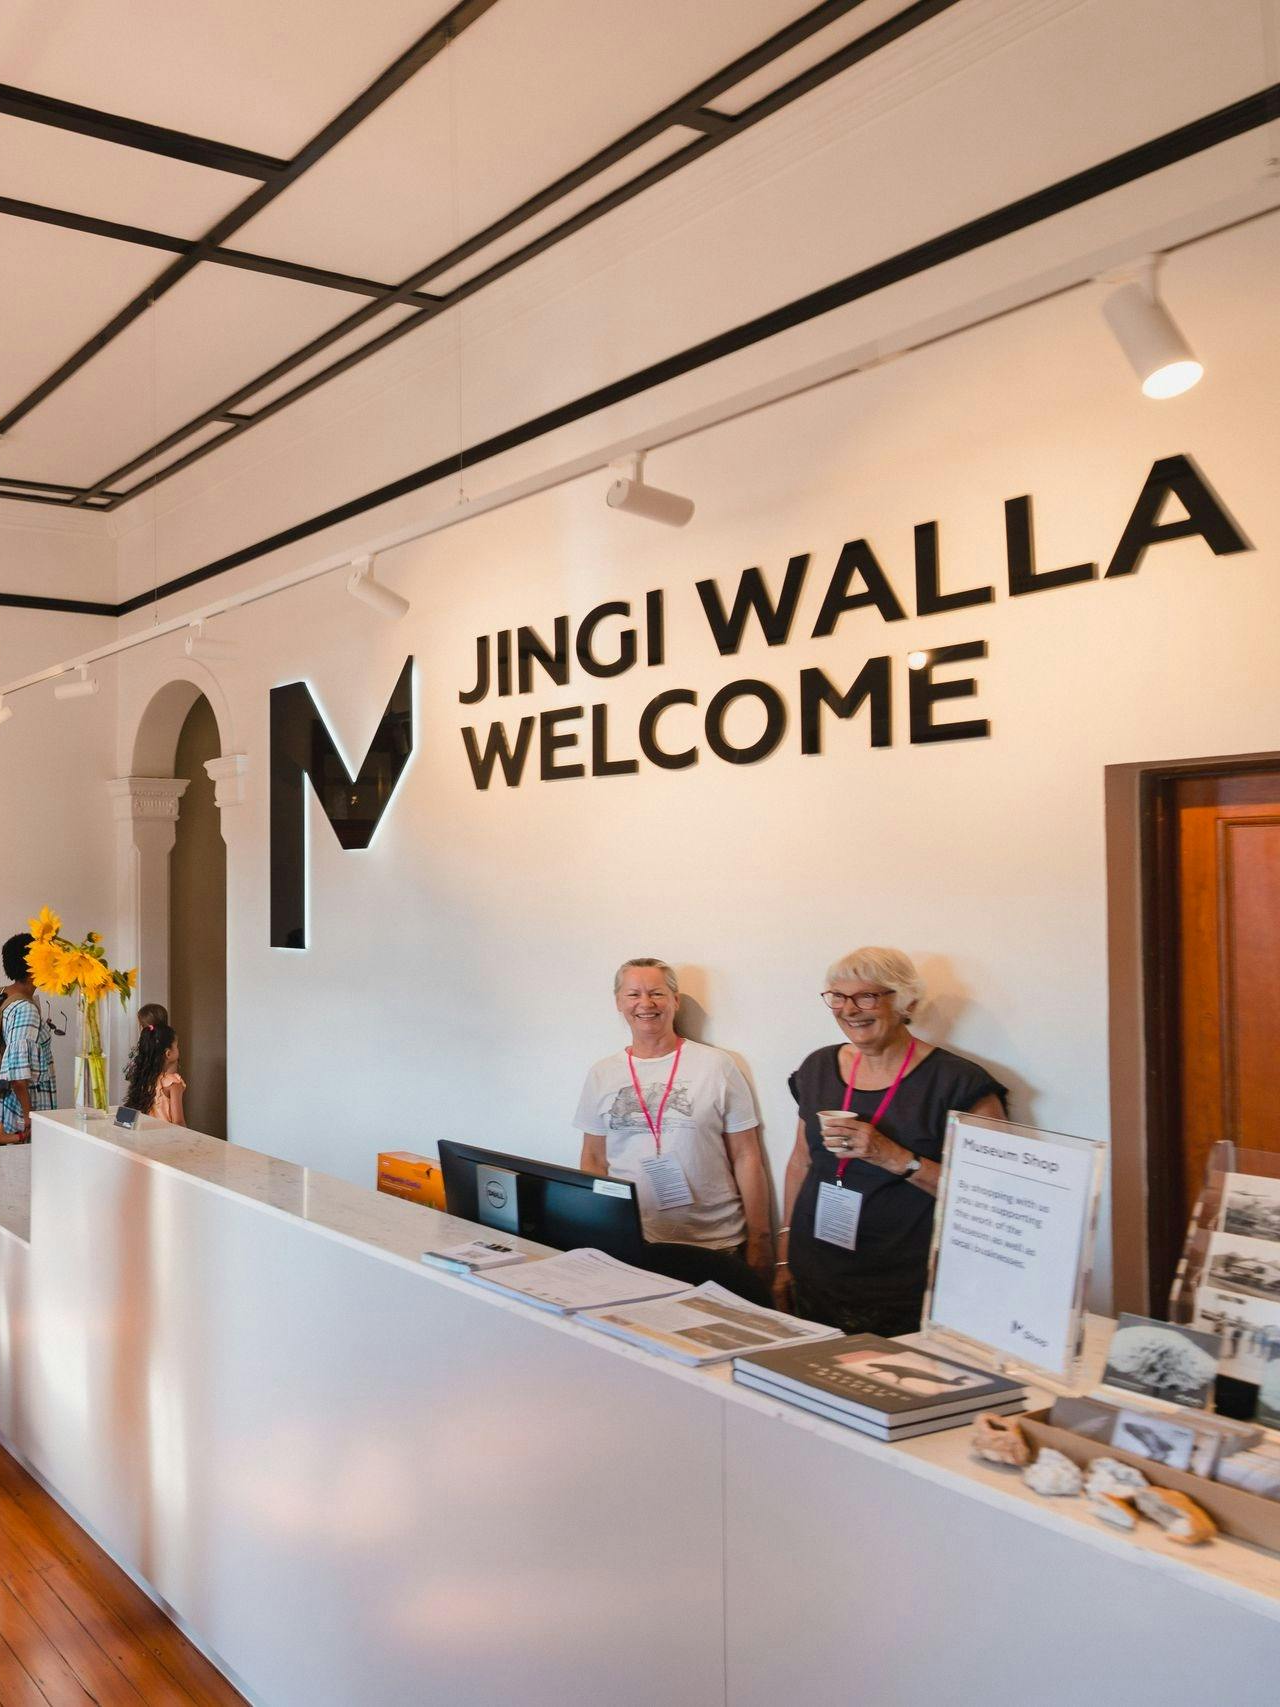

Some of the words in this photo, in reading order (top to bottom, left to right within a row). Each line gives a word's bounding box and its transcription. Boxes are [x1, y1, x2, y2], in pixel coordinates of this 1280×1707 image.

[458, 589, 665, 706] JINGI
[698, 454, 1252, 655] WALLA
[462, 640, 990, 792] WELCOME
[963, 1137, 1019, 1161] Museum
[1022, 1152, 1060, 1173] Shop
